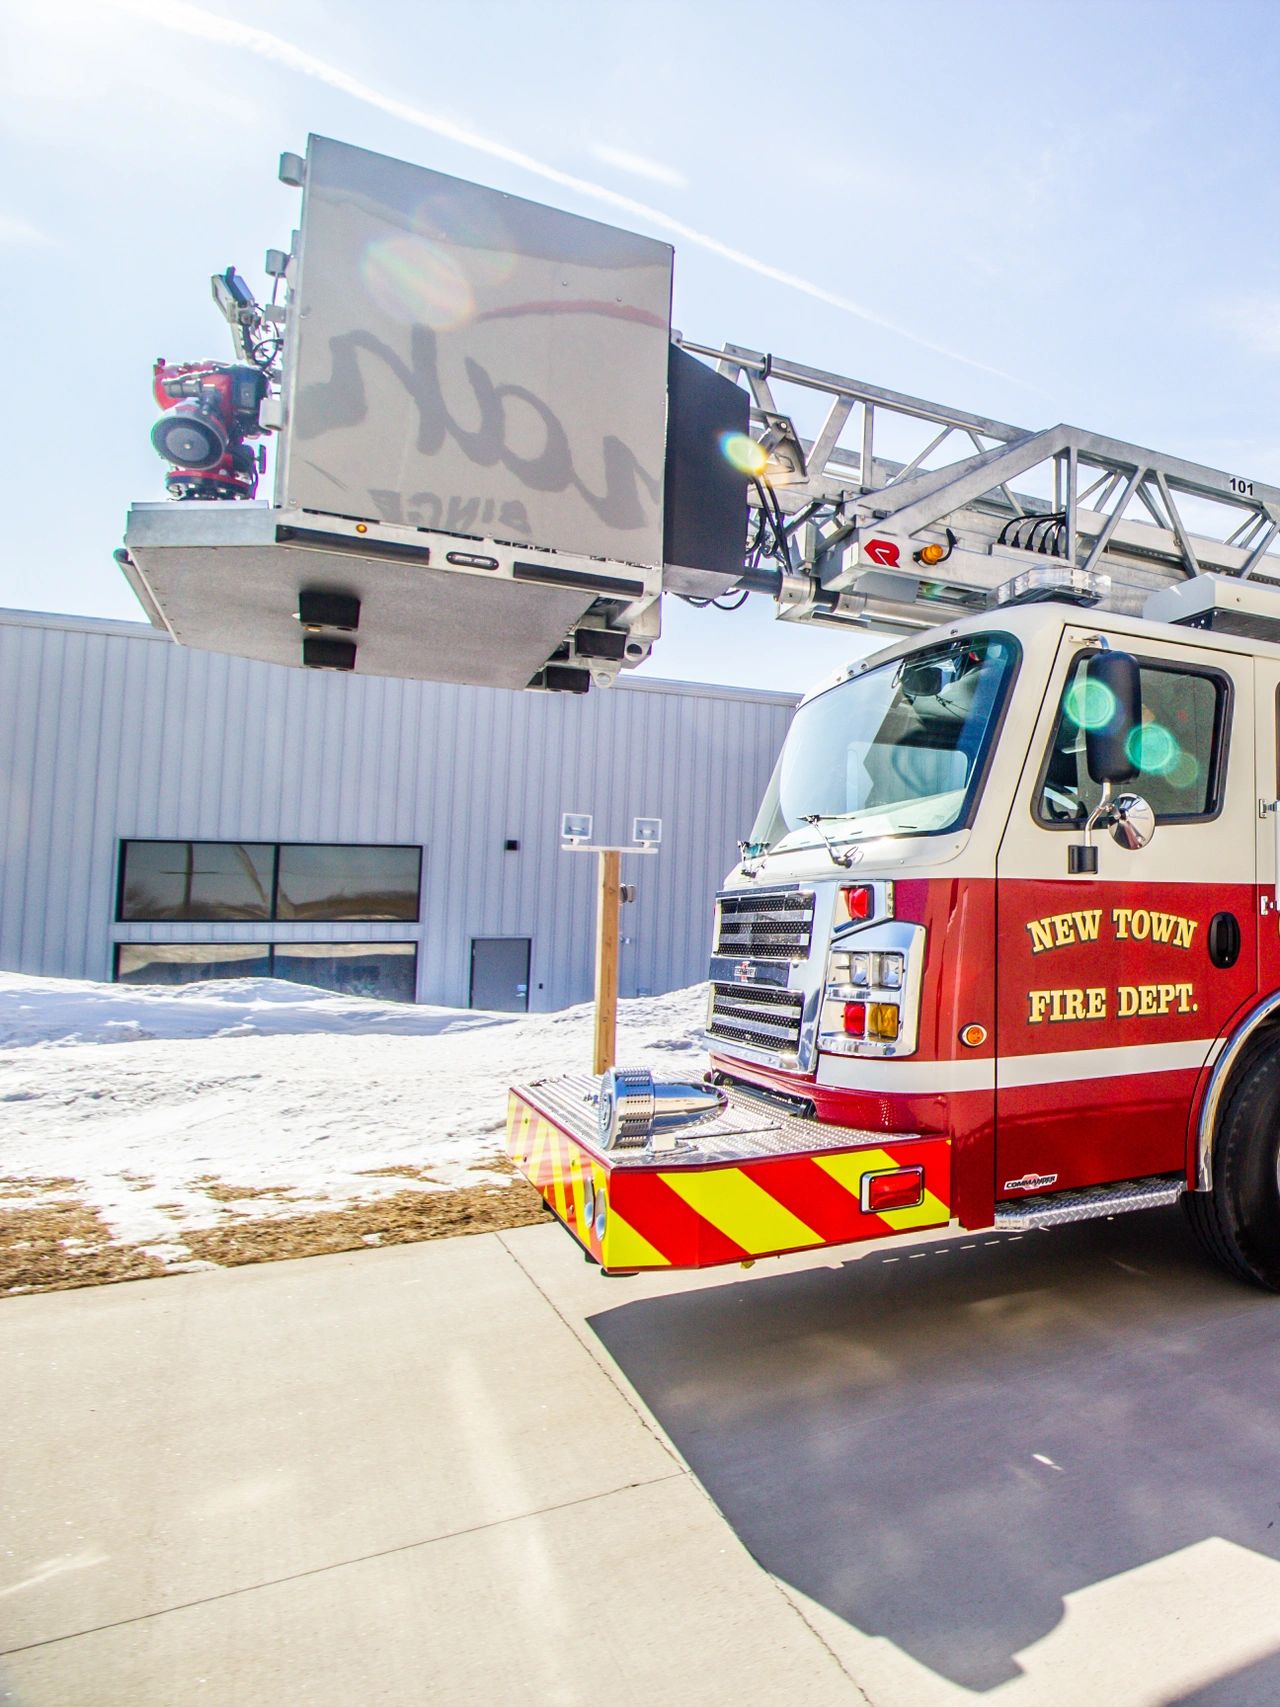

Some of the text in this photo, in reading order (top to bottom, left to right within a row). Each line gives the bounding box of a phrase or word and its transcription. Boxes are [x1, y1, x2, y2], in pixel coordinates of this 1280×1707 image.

[1229, 477, 1254, 497] 101
[1026, 908, 1199, 954] NEW TOWN
[1028, 983, 1199, 1024] FIRE DEPT.
[1005, 1175, 1056, 1189] COMMANDER
